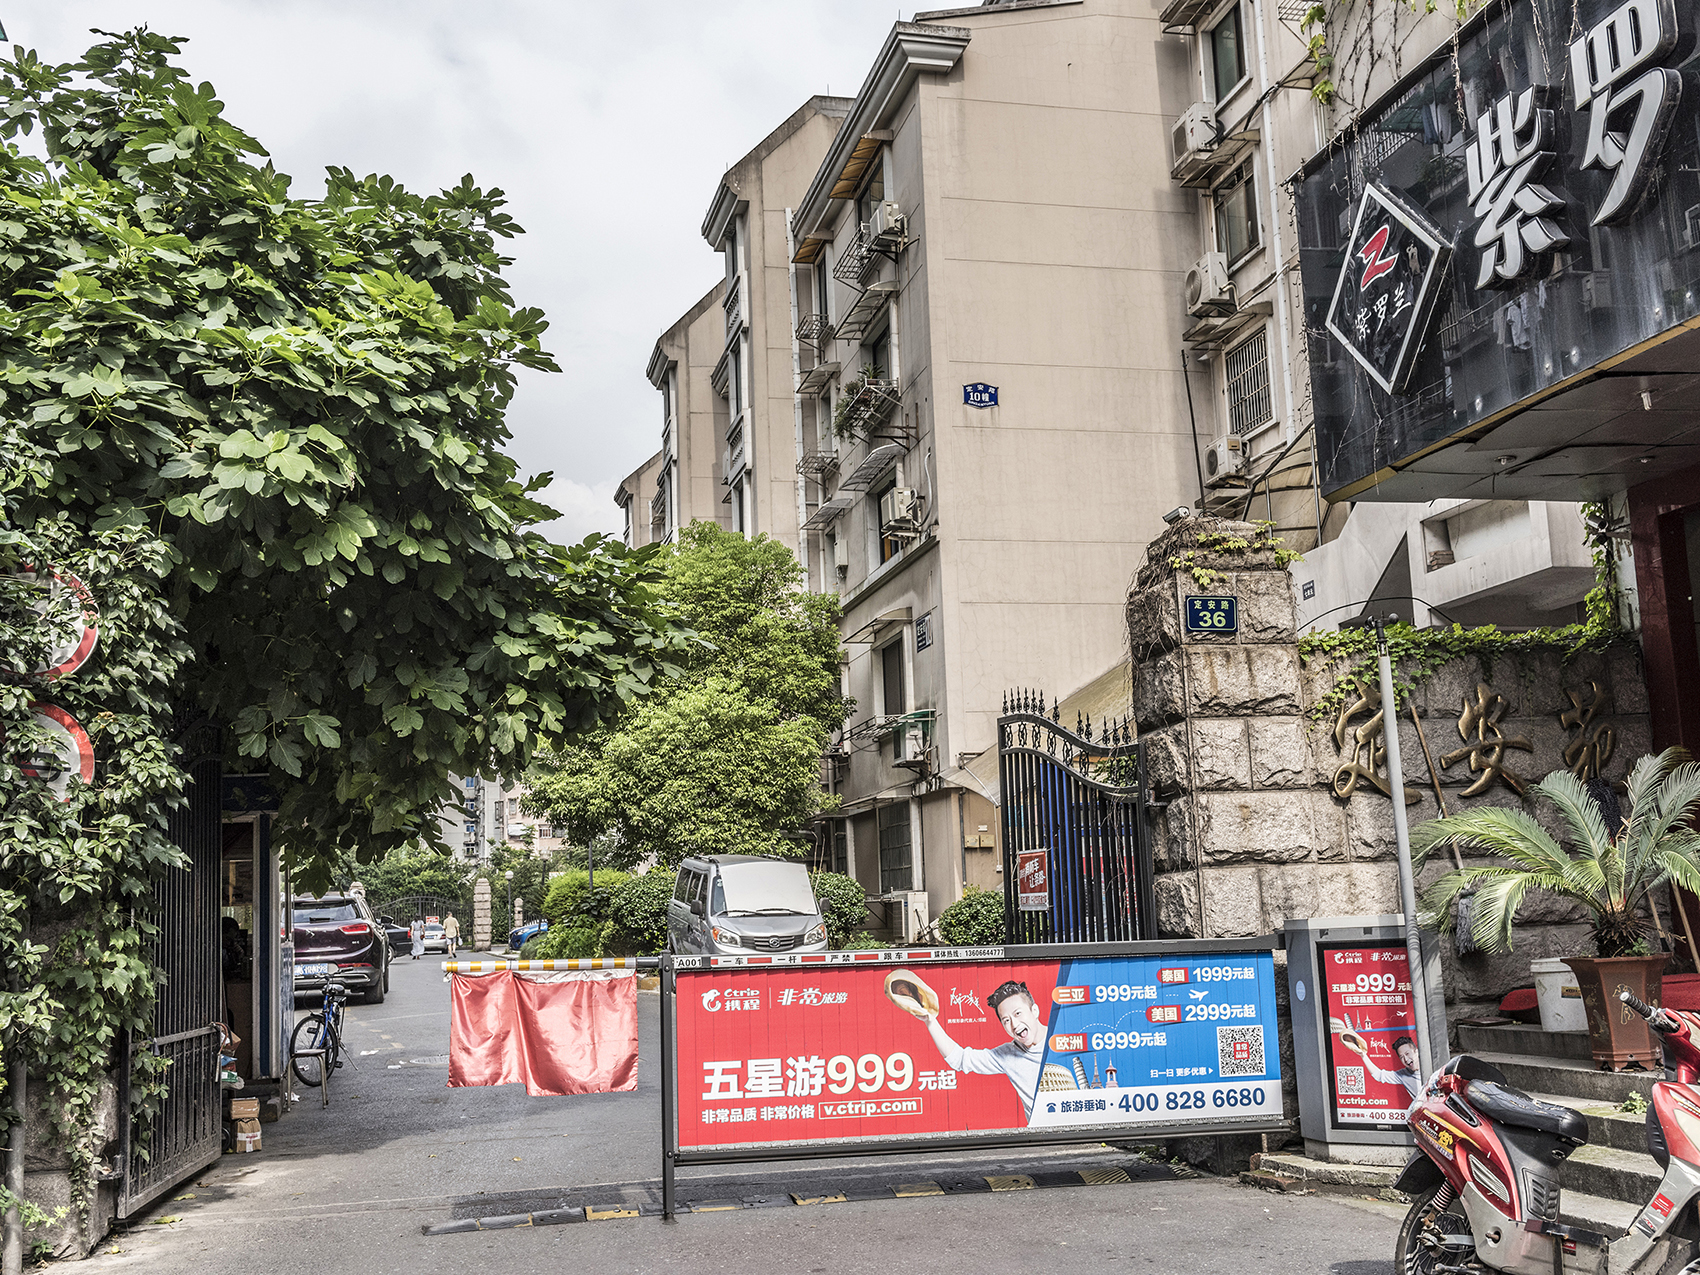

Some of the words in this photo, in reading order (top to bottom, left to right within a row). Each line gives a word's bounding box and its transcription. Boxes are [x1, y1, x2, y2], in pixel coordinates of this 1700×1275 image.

[1354, 282, 1412, 341] 紫罗兰
[1193, 599, 1229, 610] 定安路
[1198, 611, 1227, 628] 36
[677, 958, 701, 967] A001
[723, 957, 744, 965] 一车
[777, 955, 797, 964] 一杆
[830, 954, 850, 962] 严禁
[884, 952, 903, 960] 跟车
[965, 948, 1004, 957] 13606644777
[1161, 969, 1186, 983] 泰国
[1192, 966, 1255, 982] 1999元起
[723, 987, 760, 997] Ctrip
[777, 987, 848, 1006] 非常旅游
[1057, 988, 1085, 1003] 三亚
[1095, 985, 1157, 1002] 999元起
[724, 999, 760, 1012] 携程
[1151, 1007, 1178, 1022] 美国
[1185, 1003, 1256, 1021] 2999元起
[1055, 1035, 1084, 1050] 欧洲
[1091, 1031, 1167, 1050] 6999元起
[1150, 1068, 1174, 1078] 扫一扫
[1176, 1067, 1207, 1077] 更多优惠
[823, 1099, 918, 1116] v.ctrip.com
[1060, 1099, 1106, 1113] 旅游垂询
[1118, 1093, 1159, 1113] 400
[1165, 1090, 1206, 1111] 828
[1212, 1087, 1266, 1108] 6680
[1338, 1097, 1389, 1106] v.ctrip.com
[702, 1107, 757, 1124] 非常品质
[760, 1104, 815, 1121] 非常价格
[1369, 1111, 1386, 1120] 400
[1389, 1112, 1406, 1121] 828
